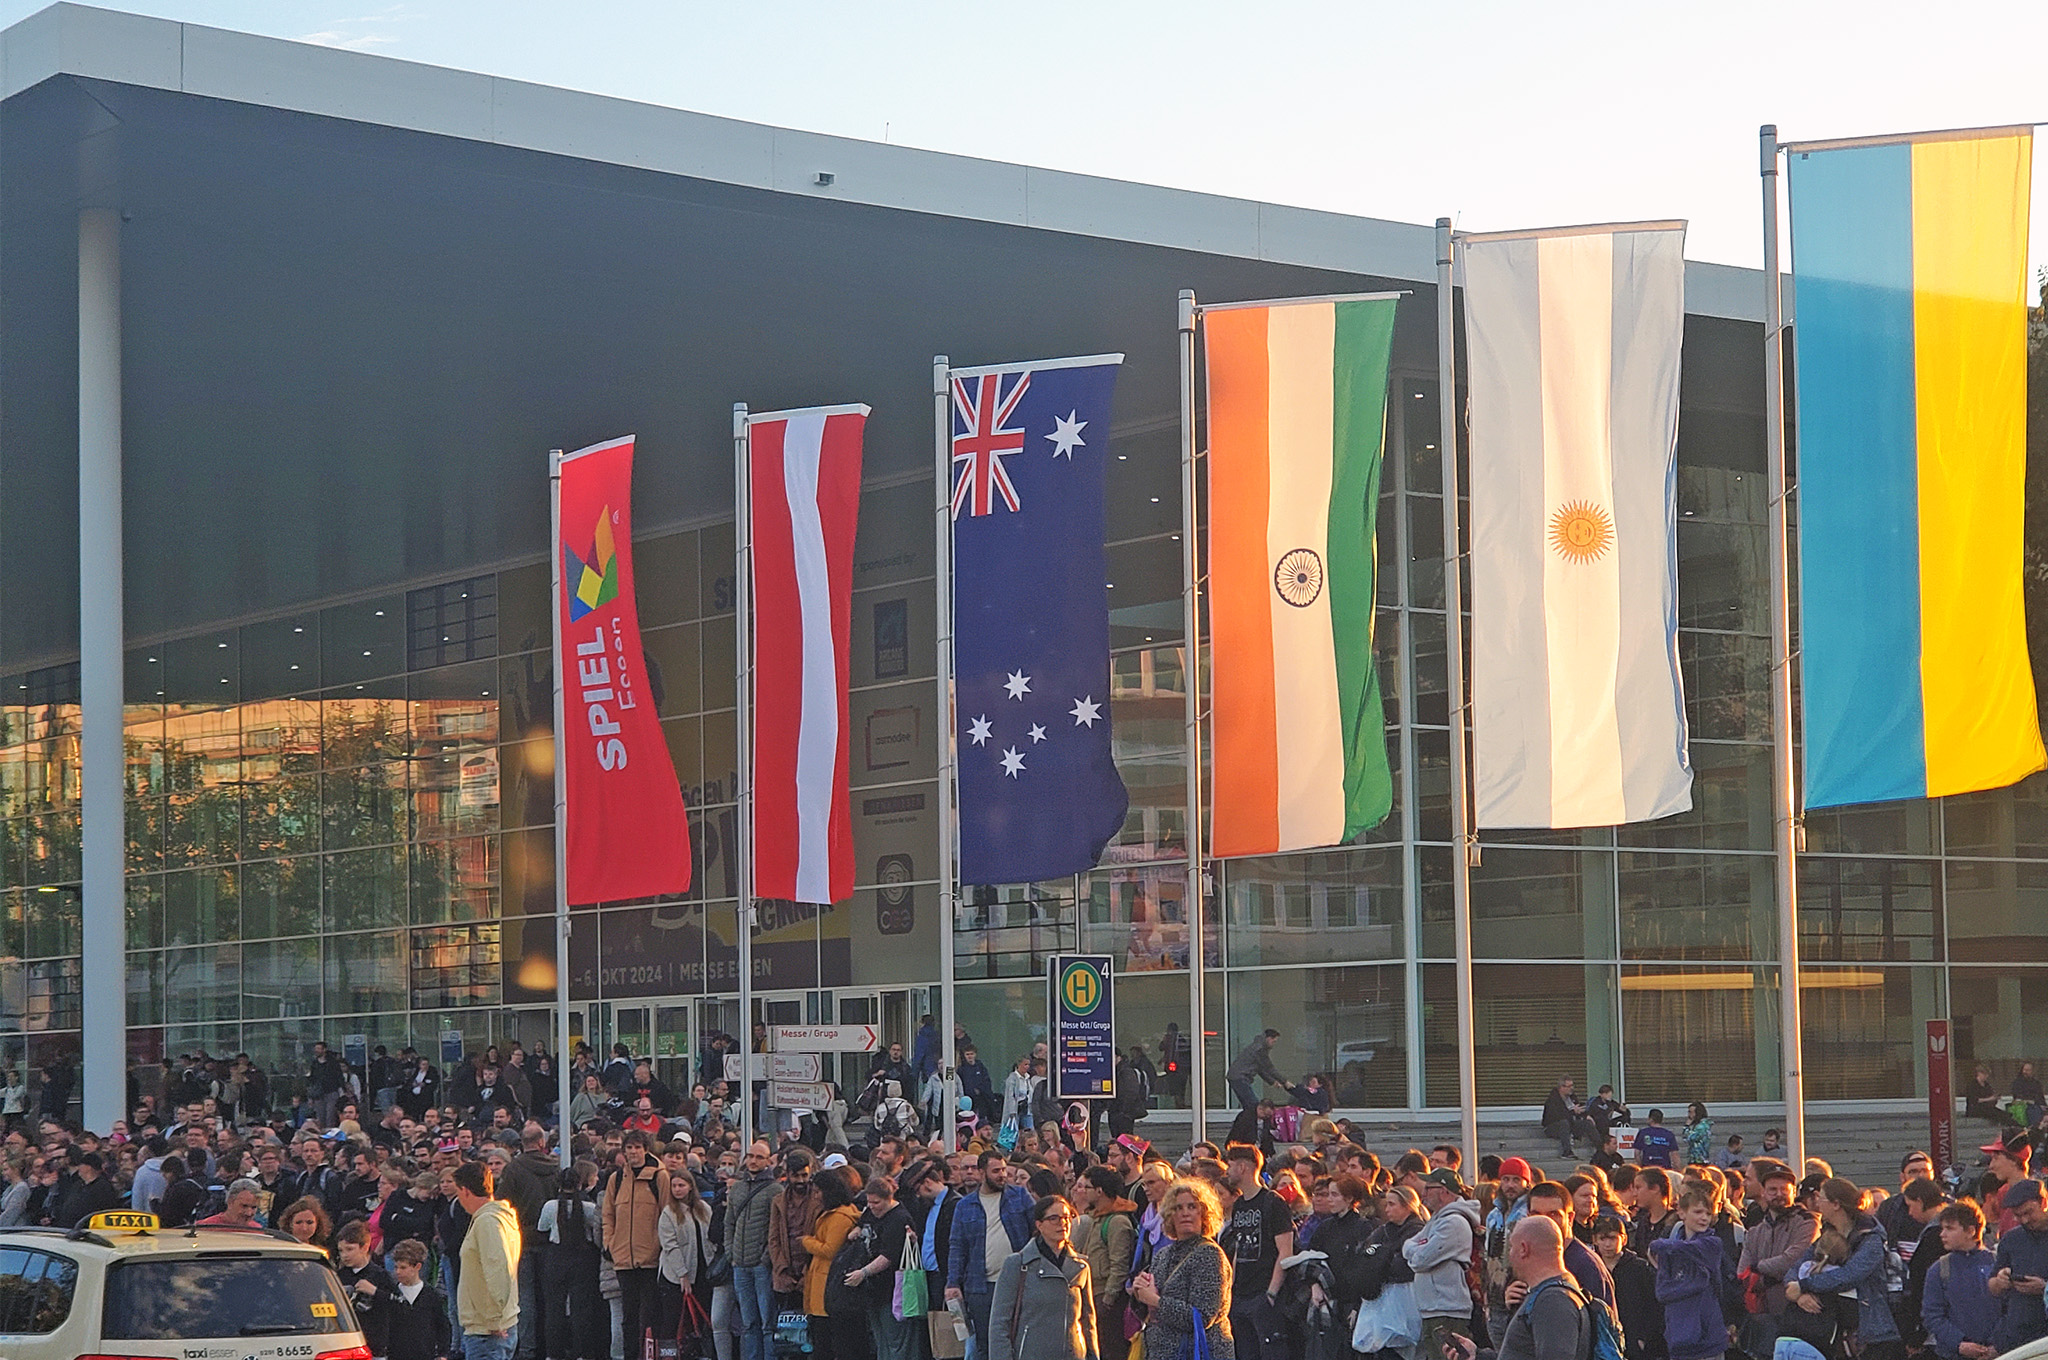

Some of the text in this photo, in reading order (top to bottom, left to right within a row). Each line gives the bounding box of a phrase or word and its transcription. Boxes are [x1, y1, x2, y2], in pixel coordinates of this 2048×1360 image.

[576, 625, 628, 772] SPIEL
[601, 967, 628, 986] OKT
[630, 965, 663, 985] 2024
[679, 961, 724, 982] MESSE
[728, 957, 772, 978] EEN
[1101, 962, 1110, 979] 4
[1073, 974, 1090, 1003] H
[1061, 1021, 1079, 1030] Messe
[781, 1029, 807, 1038] Messe
[814, 1029, 839, 1040] Gruga
[109, 1215, 147, 1227] TAXI
[777, 1314, 808, 1323] FITZEK
[183, 1347, 208, 1359] taxi
[209, 1349, 238, 1358] essen
